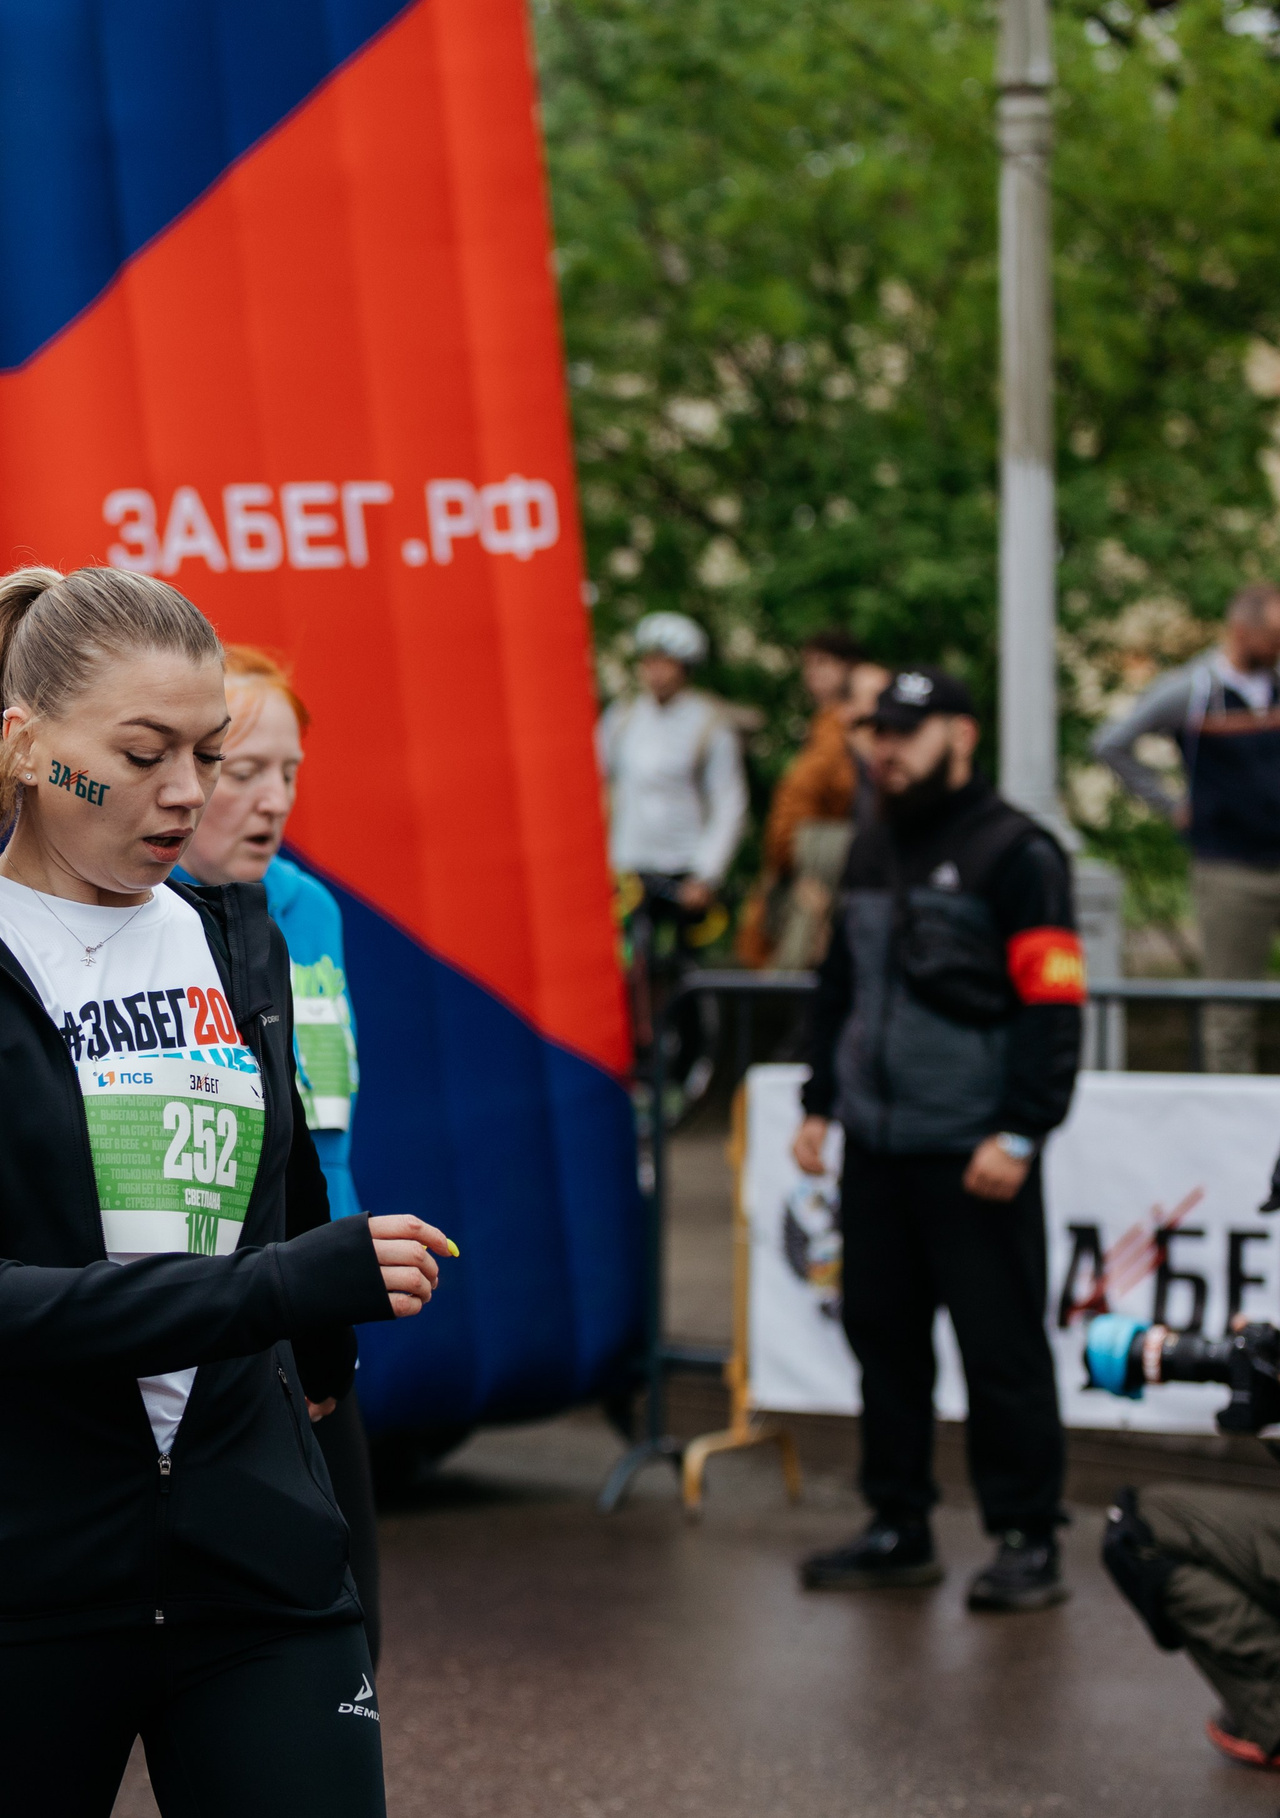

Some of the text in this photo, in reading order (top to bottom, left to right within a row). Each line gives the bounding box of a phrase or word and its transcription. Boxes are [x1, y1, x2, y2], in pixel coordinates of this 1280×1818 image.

[61, 986, 249, 1062] #ЗАБЕГ20
[120, 1072, 154, 1085] ПСБ
[101, 1109, 139, 1121] ВЫБЕГАЮ
[139, 1110, 149, 1122] ЗА
[120, 1124, 130, 1136] НА
[131, 1125, 158, 1137] СТАРТЕ
[99, 1137, 113, 1149] БЕГ
[114, 1137, 120, 1149] В
[121, 1138, 140, 1150] СЕБЕ
[163, 1101, 238, 1187] 252
[95, 1152, 151, 1165] ДАВНО ОТСТАЛ
[110, 1168, 141, 1180] ТОЛЬКО
[117, 1182, 141, 1194] ЛЮБИ
[141, 1183, 154, 1195] БЕГ
[162, 1183, 179, 1195] СЕБЕ
[125, 1197, 155, 1209] СТРЕСС
